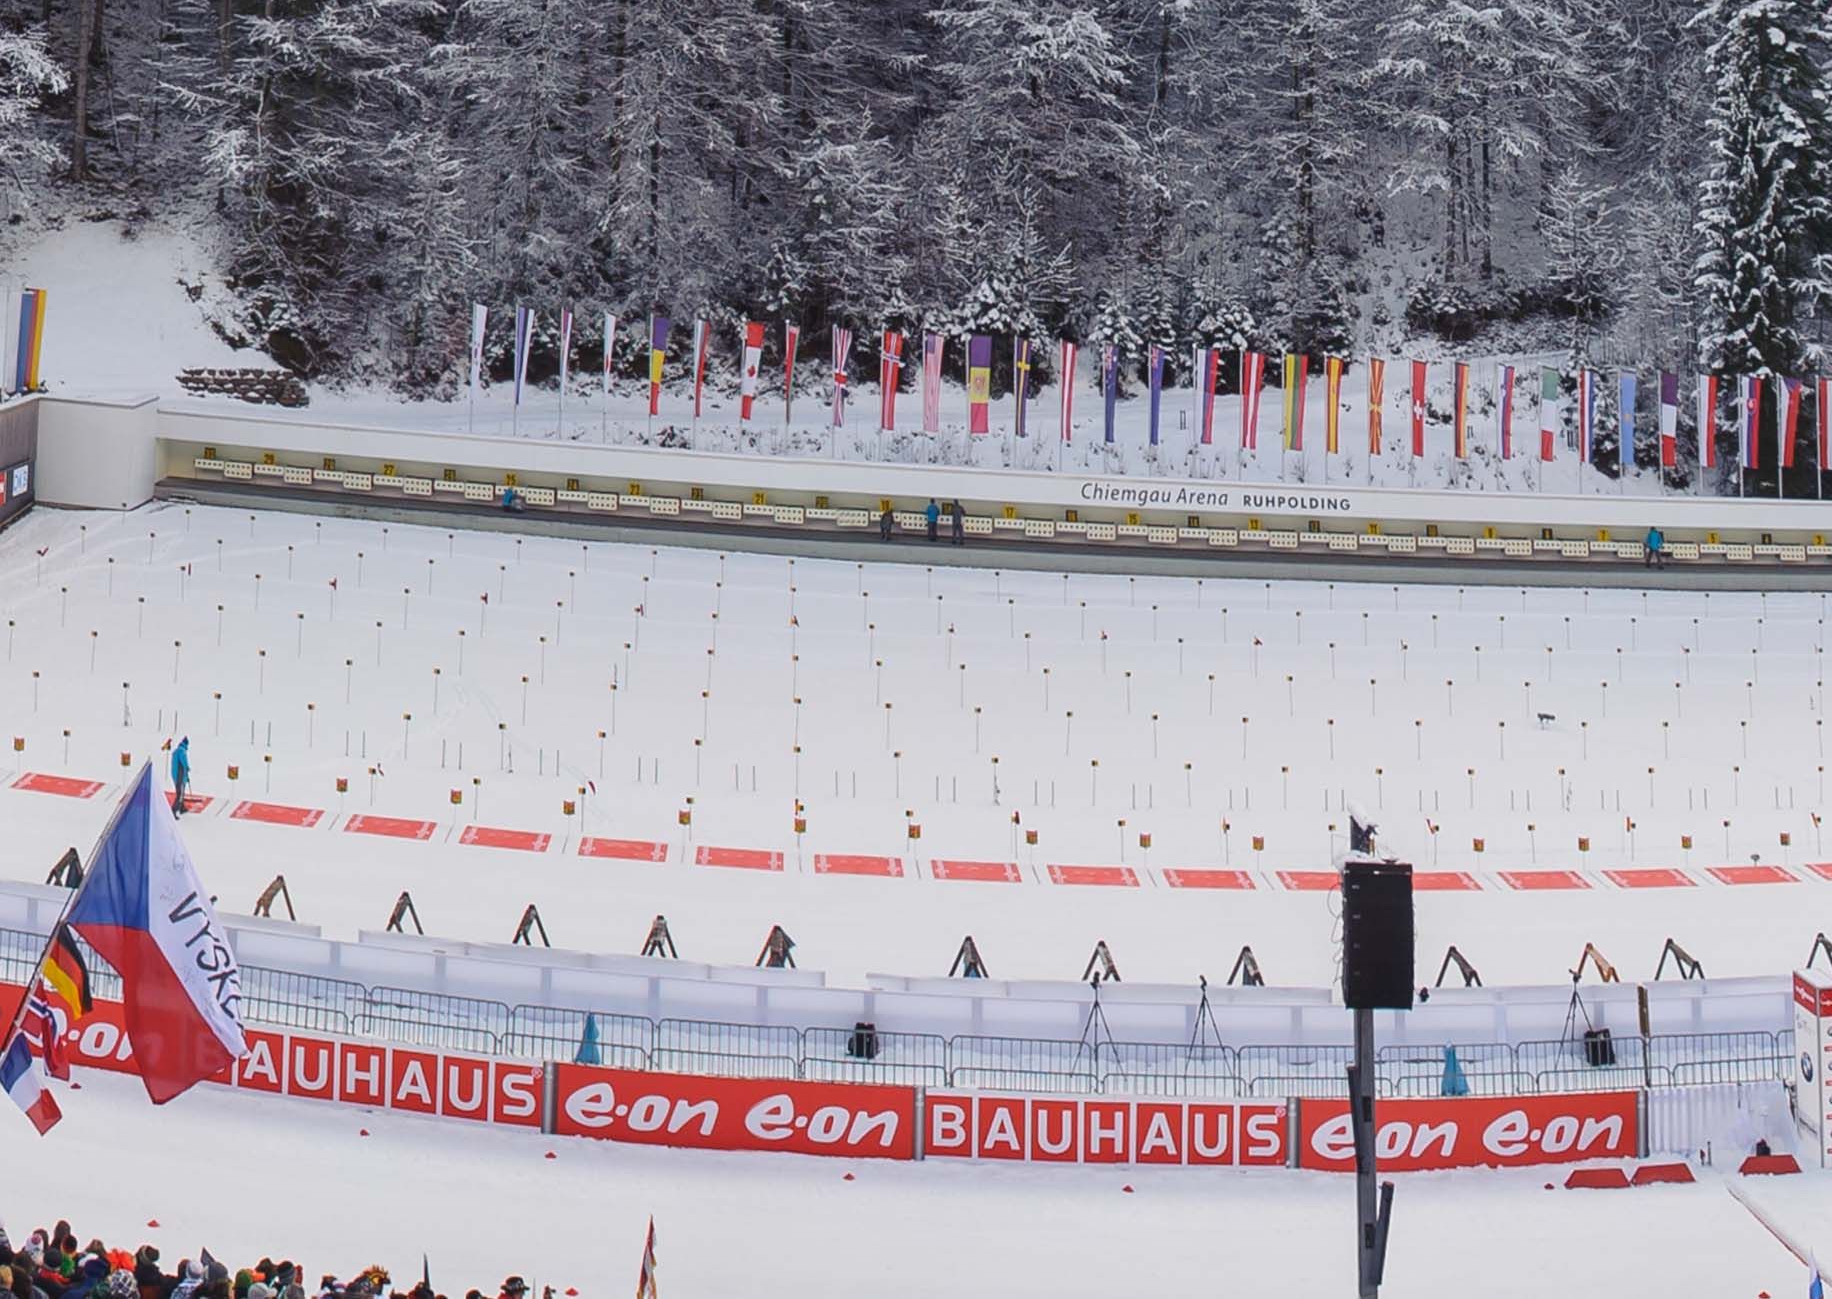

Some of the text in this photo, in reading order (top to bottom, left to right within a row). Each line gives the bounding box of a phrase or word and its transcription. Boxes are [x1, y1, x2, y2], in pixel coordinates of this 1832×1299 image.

[1081, 483, 1351, 511] Chiemgau Arena RUHPOLDING
[933, 1103, 1280, 1157] BAUHAUS
